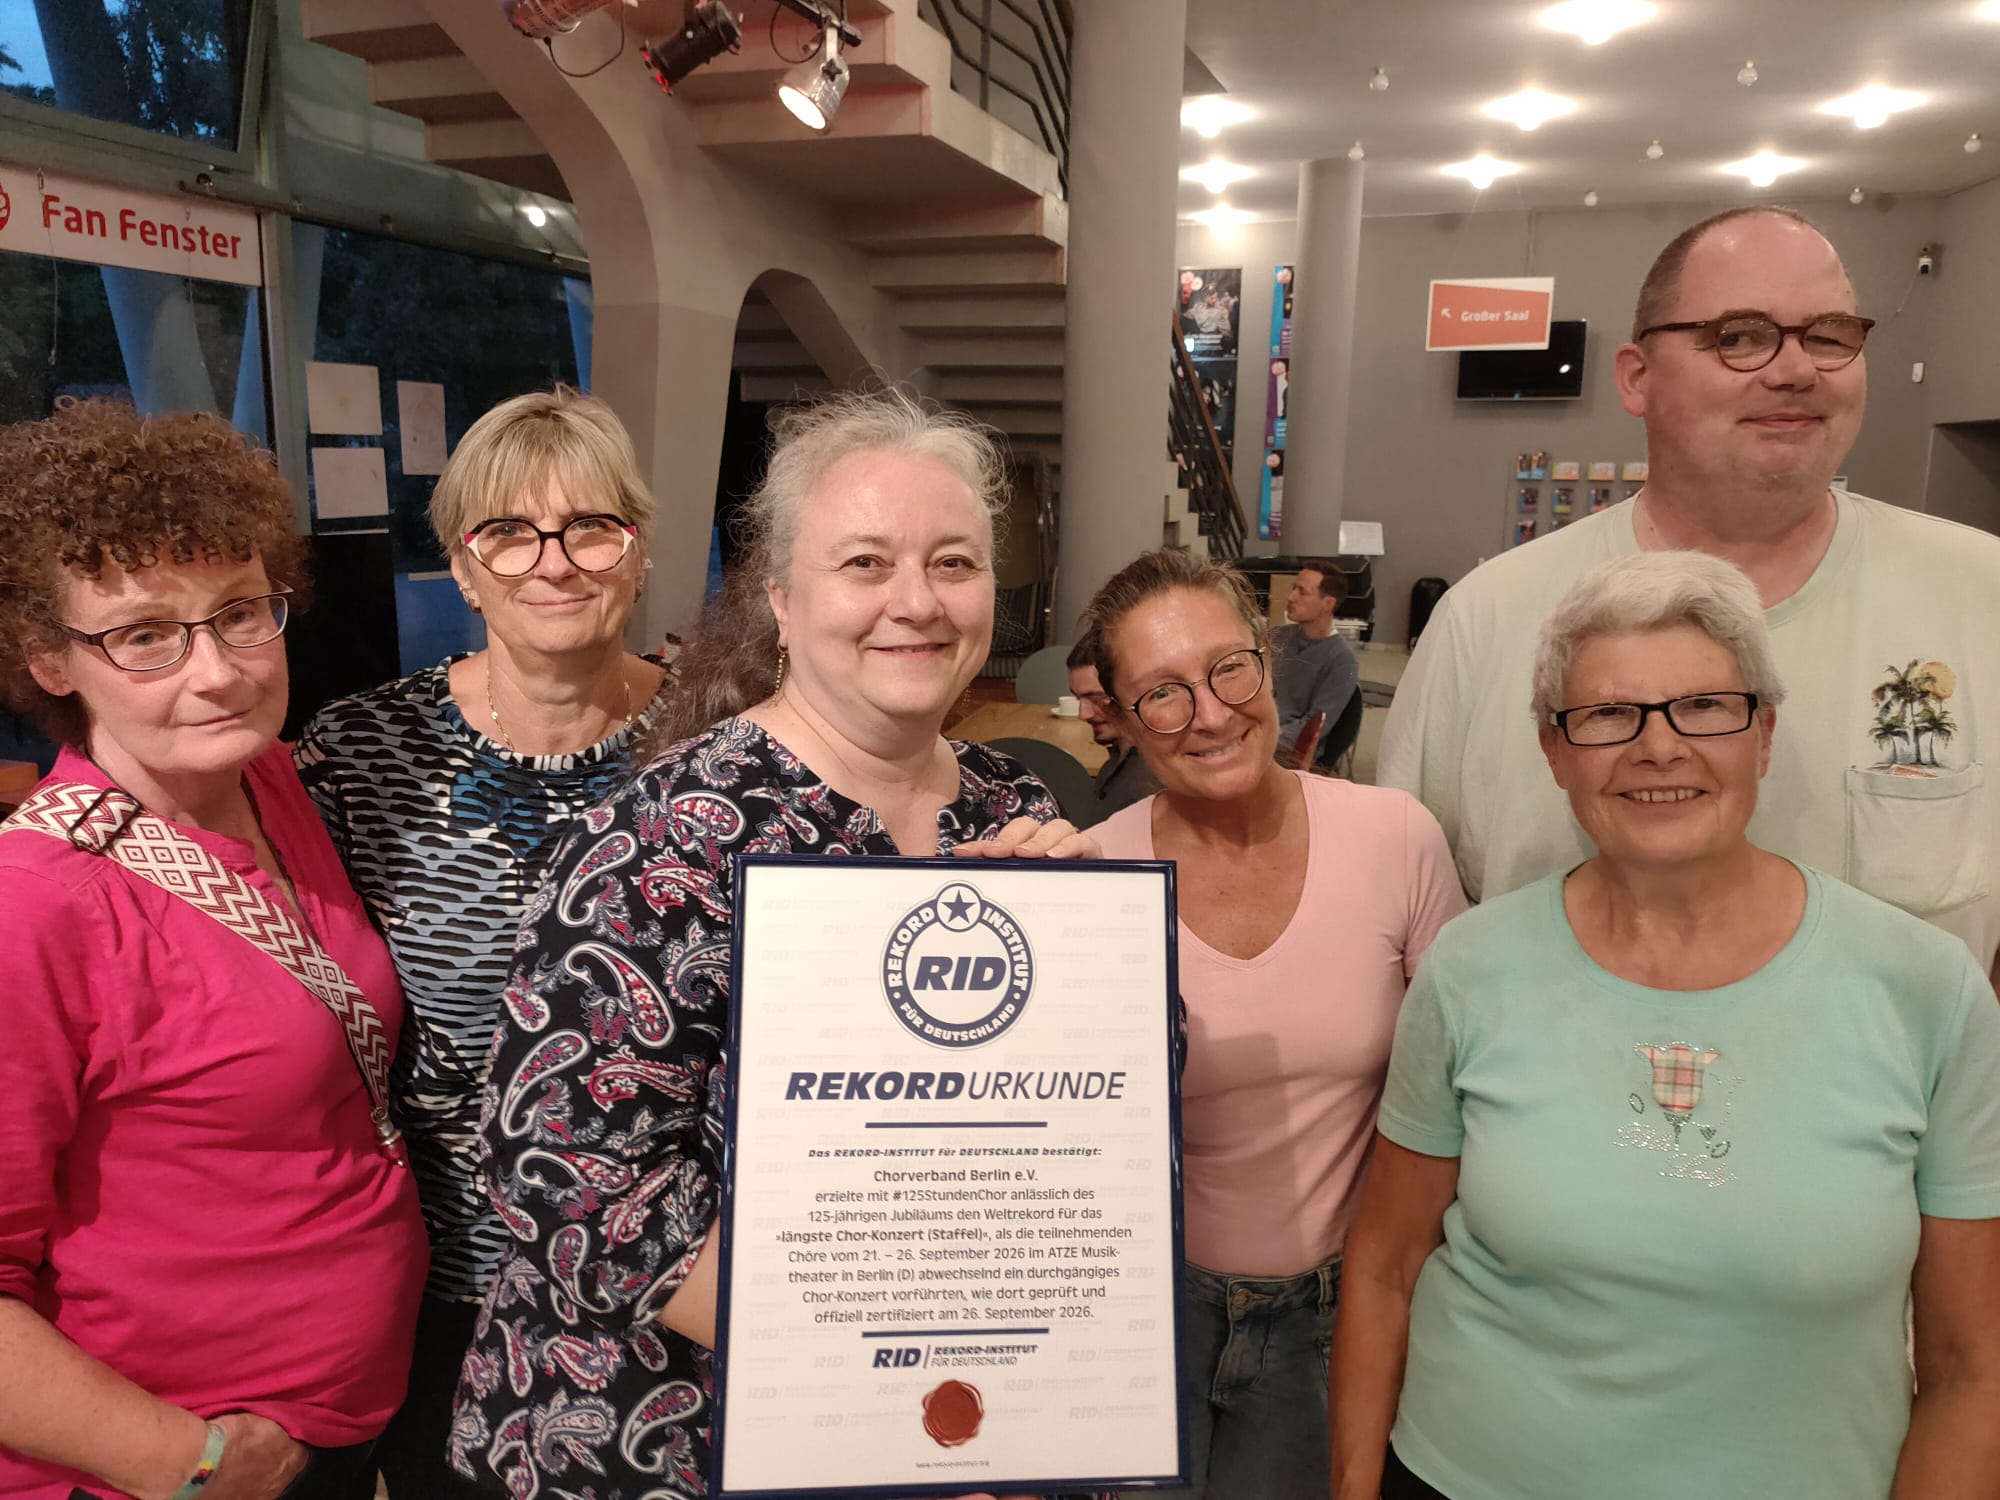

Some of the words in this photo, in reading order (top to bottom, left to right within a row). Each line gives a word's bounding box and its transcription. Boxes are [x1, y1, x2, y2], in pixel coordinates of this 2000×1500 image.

[42, 195, 107, 238] Fan
[119, 209, 241, 259] Fenster
[1461, 311, 1500, 322] Großer
[1504, 311, 1528, 321] Saal
[887, 907, 935, 988] REKORD
[982, 907, 1031, 993] INSTITUT
[912, 956, 1007, 991] RID
[900, 1002, 923, 1029] FÜR
[924, 1002, 1017, 1042] DEUTSCHLAND
[785, 1071, 1127, 1100] REKORDURKUNDE
[808, 1149, 831, 1158] Das
[834, 1148, 936, 1158] REKORD-INSTITUT
[938, 1147, 956, 1157] für
[959, 1147, 1039, 1157] DEUTSCHLAND
[1042, 1146, 1102, 1157] bestätigt:
[874, 1169, 966, 1182] Chorverband
[970, 1169, 1010, 1181] Berlin
[1015, 1169, 1038, 1181] e.V.
[815, 1191, 864, 1202] erzielte
[867, 1190, 889, 1202] mit
[893, 1189, 1007, 1201] #125StundenChor
[1011, 1188, 1070, 1200] anlässlich
[1073, 1188, 1095, 1199] des
[808, 1210, 887, 1224] 125-jährigen
[890, 1209, 953, 1221] Jubiläums
[957, 1208, 980, 1220] den
[984, 1208, 1055, 1220] Weltrekord
[1058, 1208, 1078, 1219] für
[1081, 1208, 1102, 1219] das
[836, 1229, 924, 1242] Chor-Konzert
[995, 1228, 1013, 1239] als
[1016, 1227, 1034, 1239] die
[1038, 1227, 1132, 1239] teilnehmenden
[788, 1251, 827, 1263] Chöre
[830, 1252, 859, 1262] vom
[863, 1249, 880, 1261] 21.
[896, 1249, 916, 1261] 26.
[919, 1248, 990, 1262] September
[994, 1247, 1025, 1259] 2026
[1029, 1247, 1044, 1259] im
[1047, 1247, 1079, 1259] ATZE
[1082, 1246, 1120, 1258] Musik-
[788, 1271, 839, 1283] theater
[842, 1270, 854, 1281] in
[857, 1269, 894, 1281] Berlin
[897, 1268, 915, 1282] (D)
[918, 1267, 1001, 1280] abwechselnd
[1005, 1267, 1024, 1279] ein
[1027, 1266, 1120, 1280] durchgängiges
[803, 1290, 888, 1303] Chor-Konzert
[891, 1288, 968, 1301] vorführten,
[970, 1287, 993, 1299] wie
[996, 1287, 1025, 1299] dort
[1028, 1286, 1079, 1300] geprüft
[1081, 1285, 1105, 1299] und
[815, 1309, 863, 1323] offiziell
[866, 1308, 934, 1322] zertifiziert
[938, 1310, 958, 1320] am
[962, 1307, 981, 1320] 26.
[985, 1306, 1056, 1320] September
[1059, 1306, 1094, 1318] 2026.
[872, 1348, 922, 1368] RID
[933, 1344, 1038, 1356] REKORD-INSTITUT
[930, 1356, 950, 1367] FÜR
[951, 1355, 1018, 1367] DEUTSCHLAND
